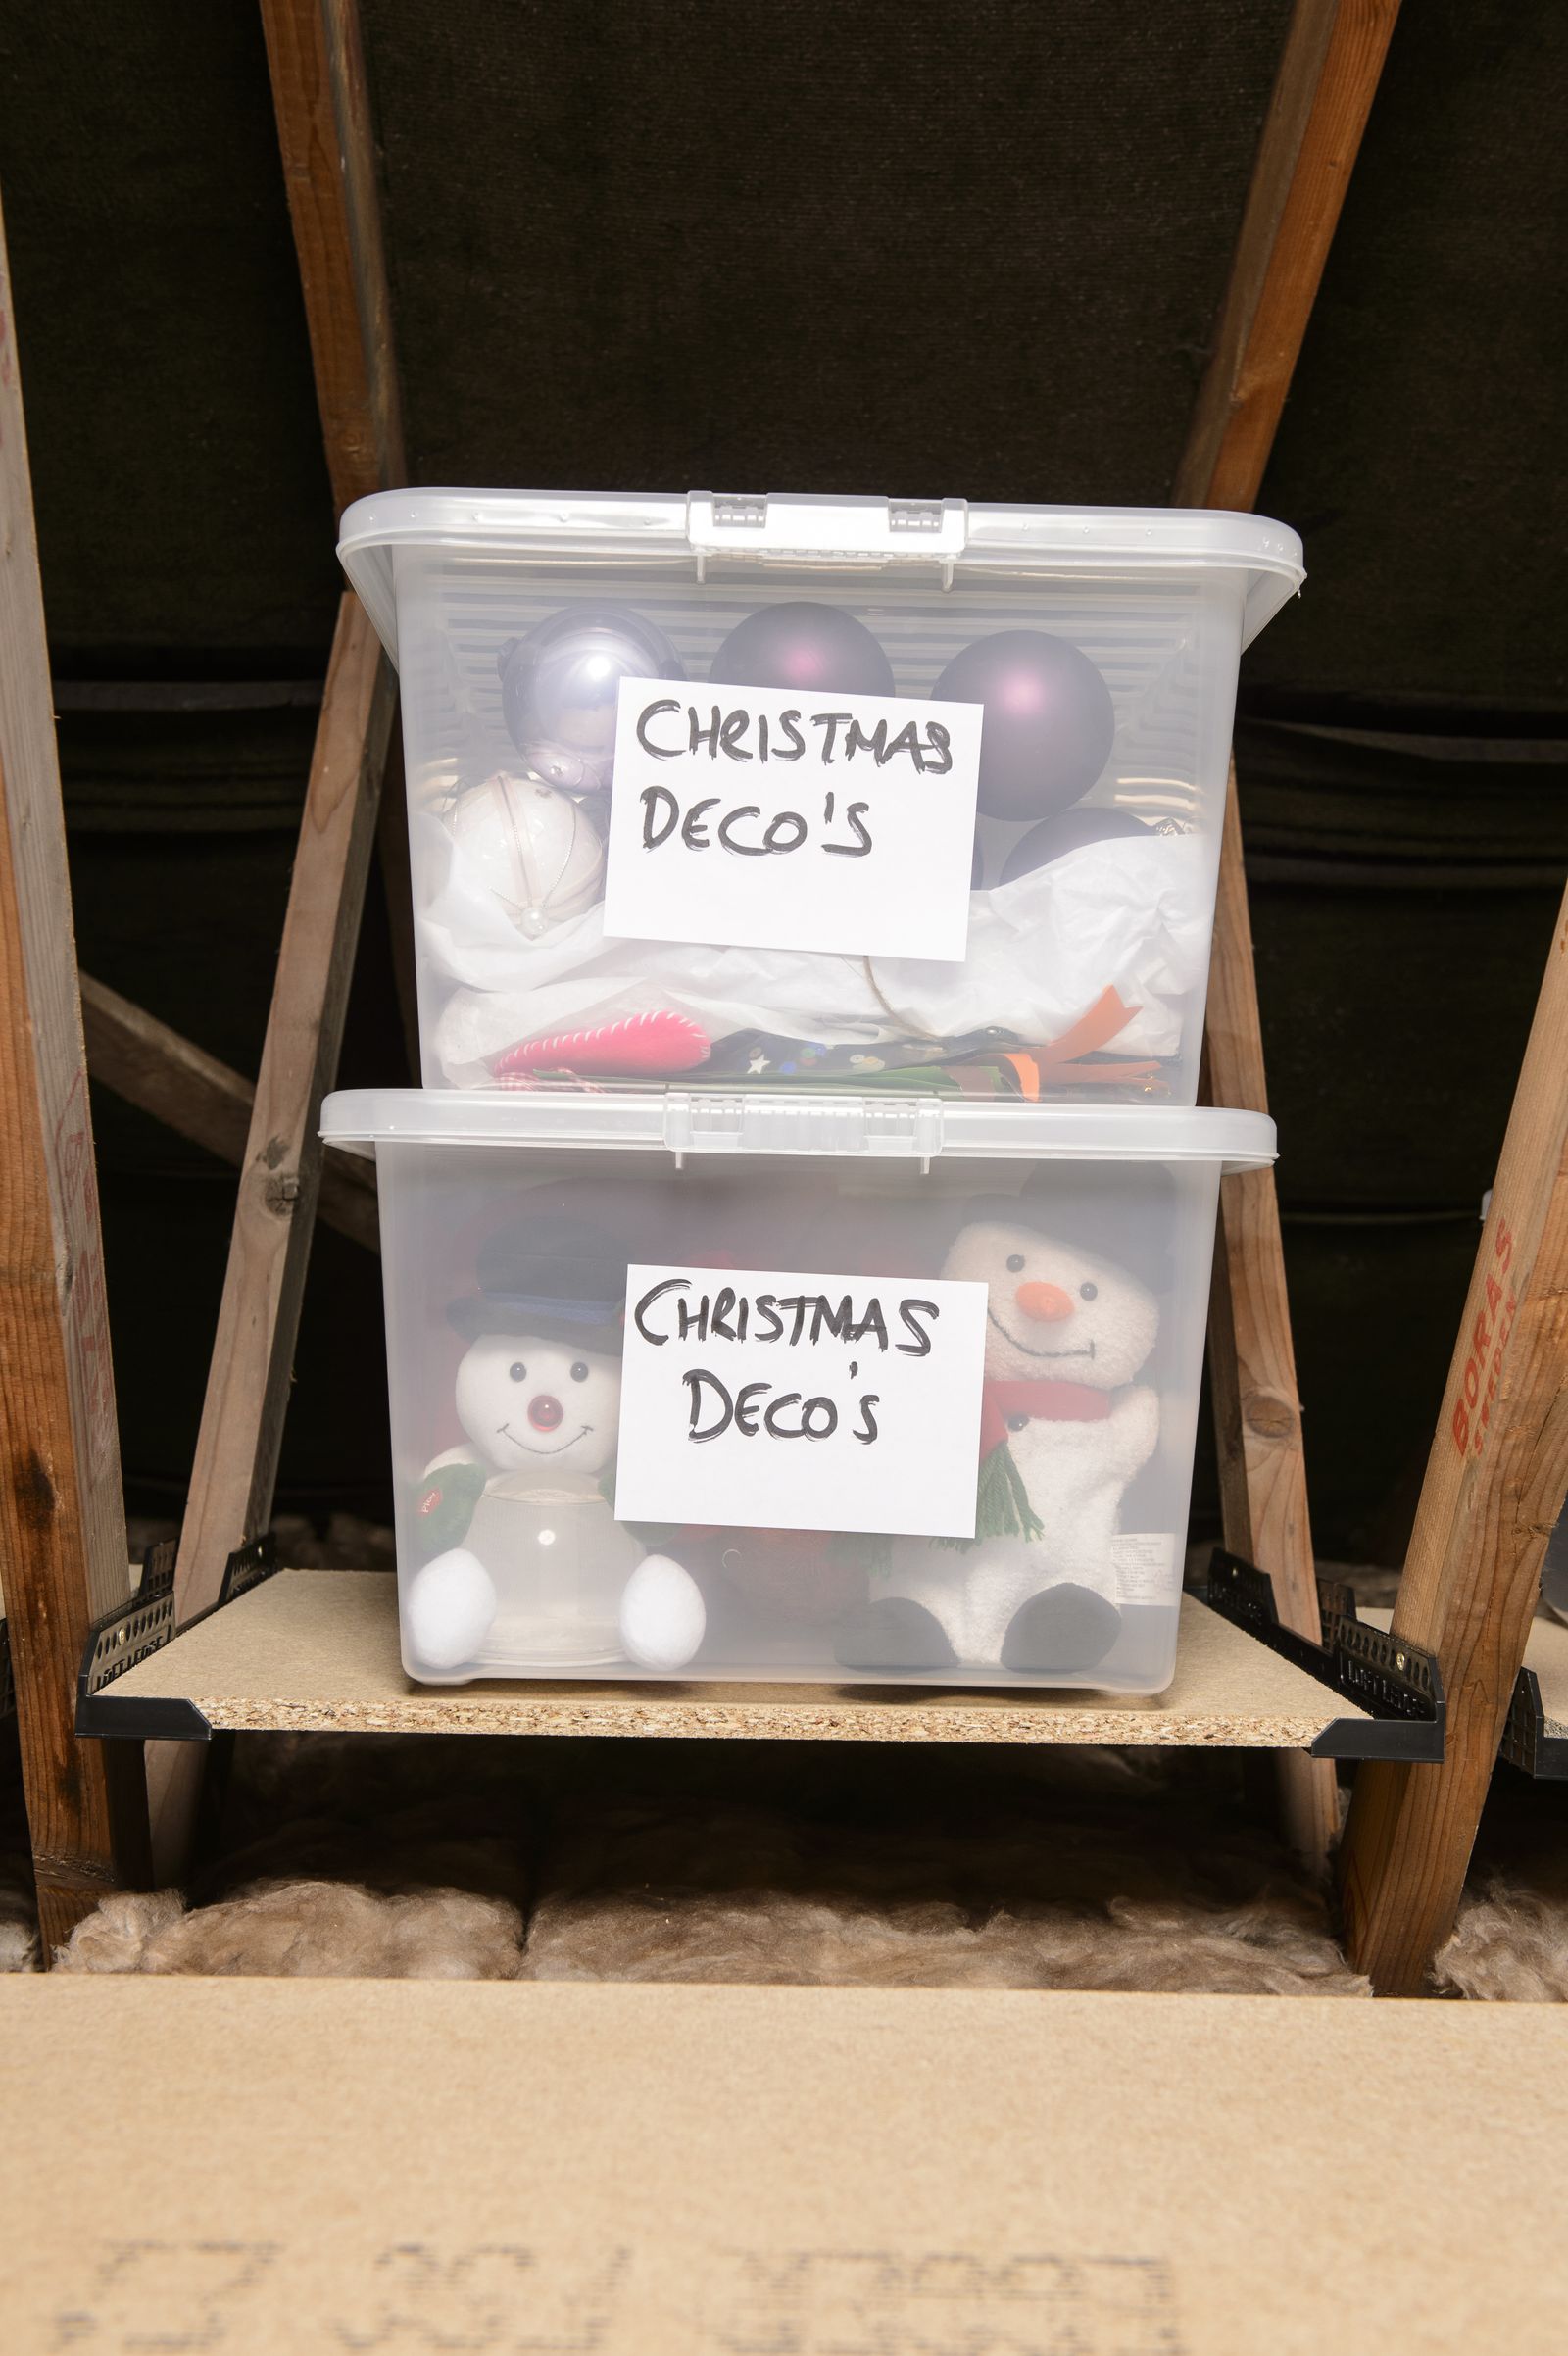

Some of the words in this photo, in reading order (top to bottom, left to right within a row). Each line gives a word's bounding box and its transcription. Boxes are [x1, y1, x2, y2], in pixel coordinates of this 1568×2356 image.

[636, 699, 954, 775] CHRISTMAS
[640, 785, 873, 857] DECO'S
[634, 1278, 940, 1356] CHRISTMAS
[682, 1361, 880, 1445] DECO'S
